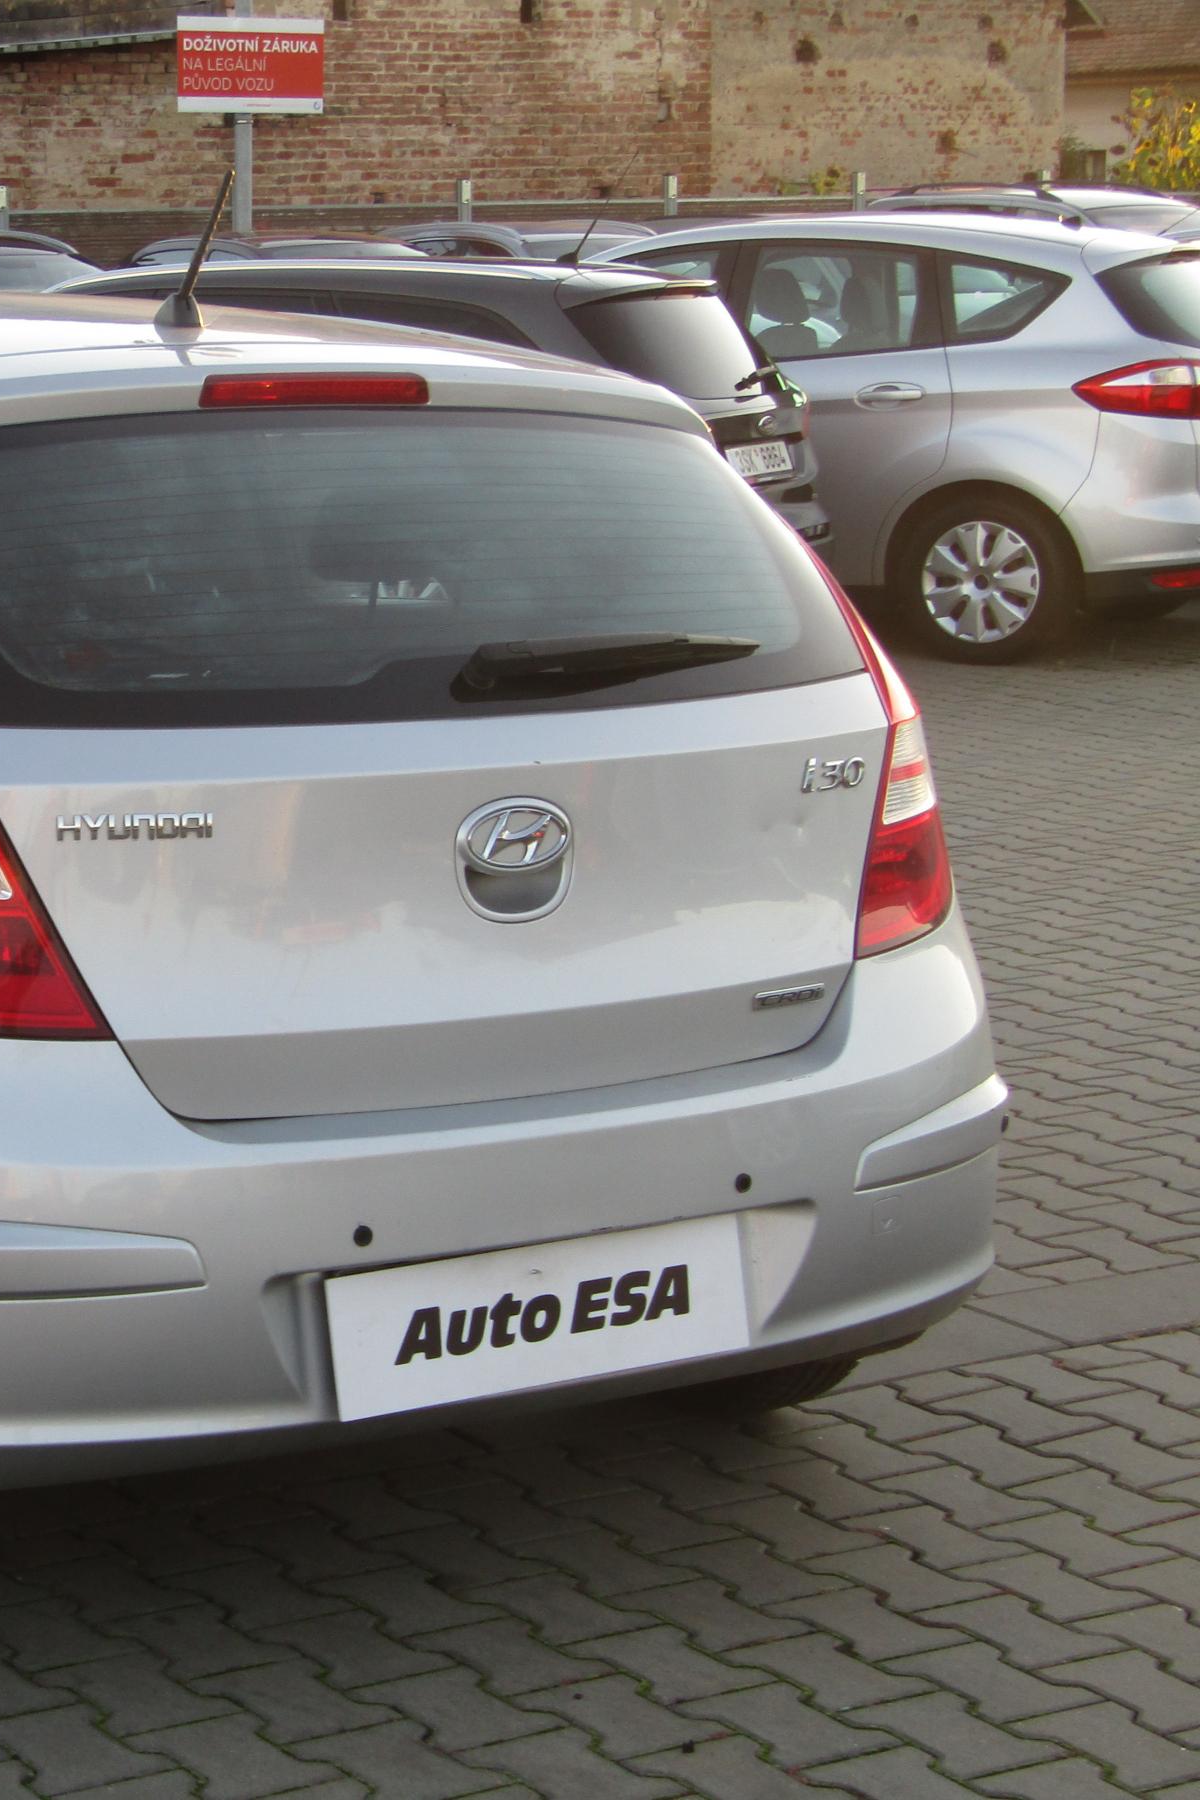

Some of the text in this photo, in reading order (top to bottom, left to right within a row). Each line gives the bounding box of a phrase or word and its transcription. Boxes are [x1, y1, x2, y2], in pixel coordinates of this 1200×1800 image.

[182, 36, 318, 53] DOŽIVOTNÍ ZÁRUKA
[182, 56, 266, 72] NA LEGÁLNÍ
[182, 73, 275, 91] PŮVOD VOZU
[56, 813, 213, 841] HYUNDAI
[394, 1264, 690, 1365] Auto ESA
